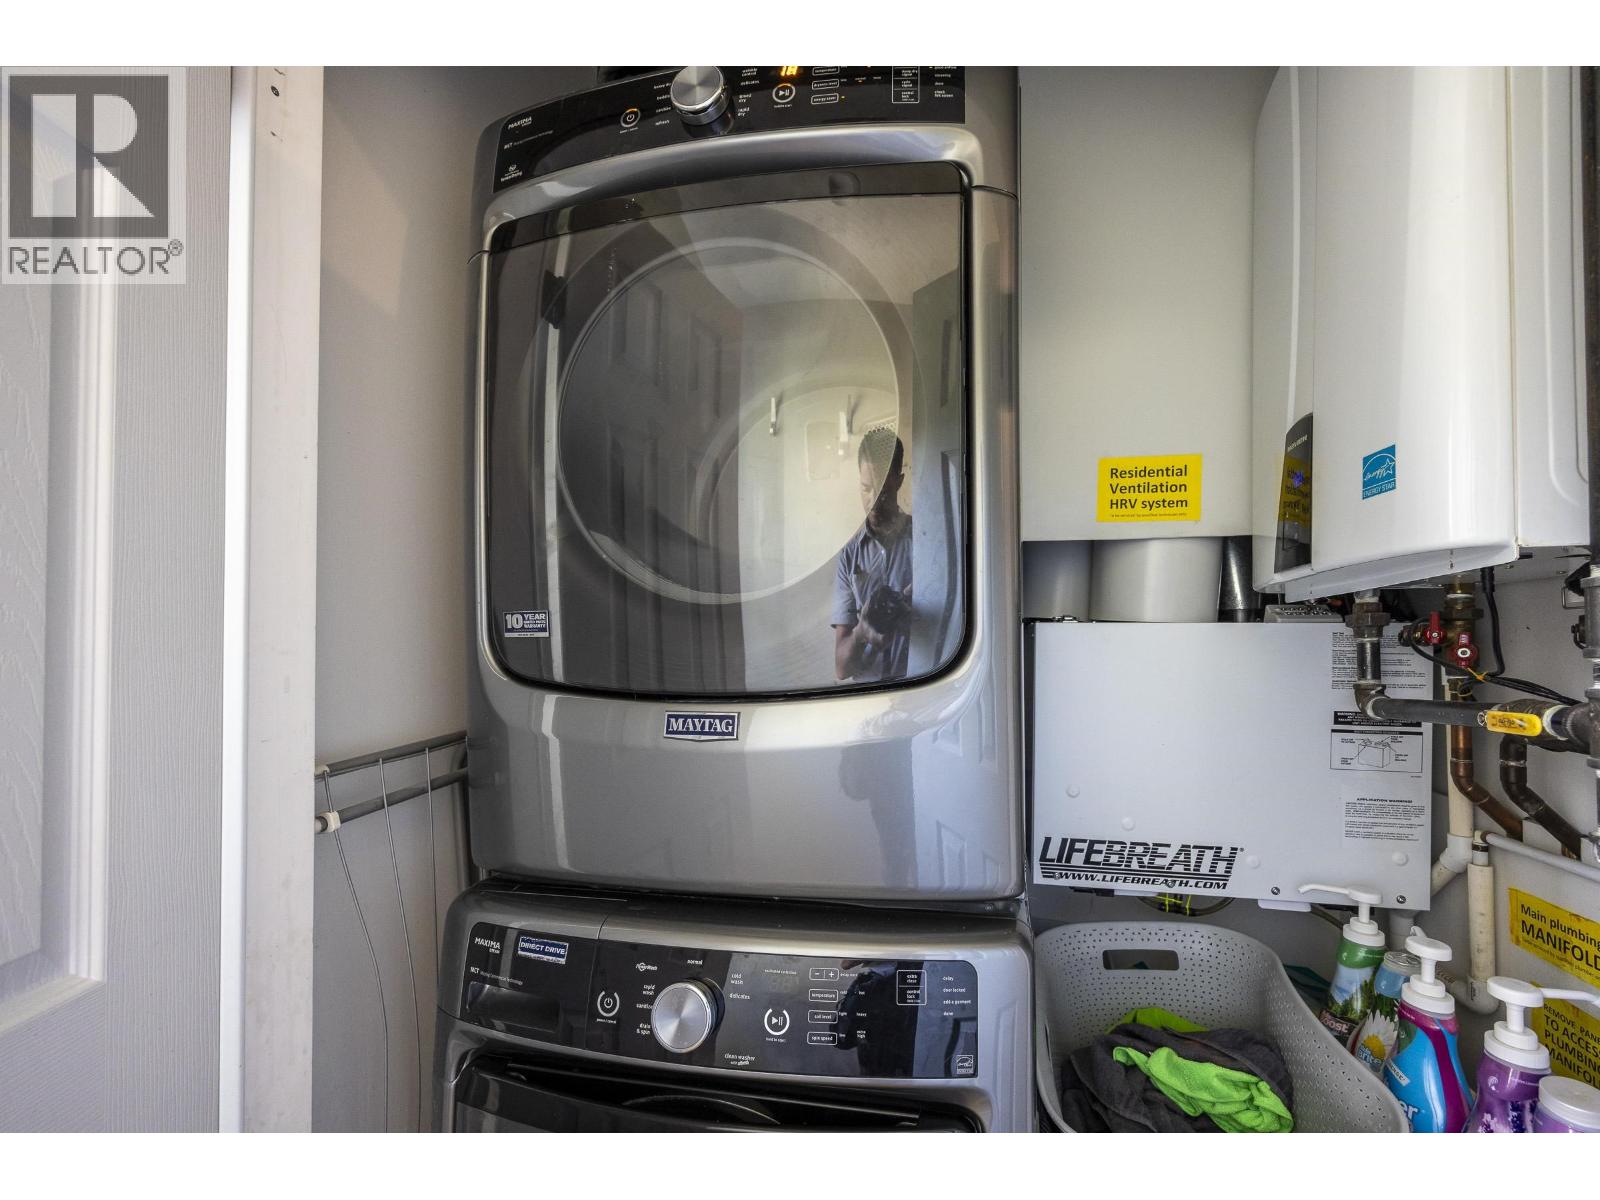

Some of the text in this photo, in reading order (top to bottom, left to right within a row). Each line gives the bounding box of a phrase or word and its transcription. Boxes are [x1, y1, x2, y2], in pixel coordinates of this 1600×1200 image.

[1110, 464, 1188, 479] Residential
[1109, 481, 1188, 495] Ventilation
[1382, 481, 1396, 492] STAR
[1109, 497, 1189, 512] HRV system
[505, 613, 546, 629] 10 YEAR
[668, 717, 733, 733] MAYTAG
[1059, 871, 1228, 890] WWW.LIFEBREATH.COM
[1520, 903, 1547, 925] Main
[1549, 918, 1600, 953] plumbing
[474, 936, 501, 950] MAXIMA
[520, 941, 566, 956] DIRECT DRIVE
[1520, 919, 1600, 972] MANIFOLD
[1543, 1003, 1577, 1029] REMOVE
[1544, 1013, 1600, 1060] TO ACCES
